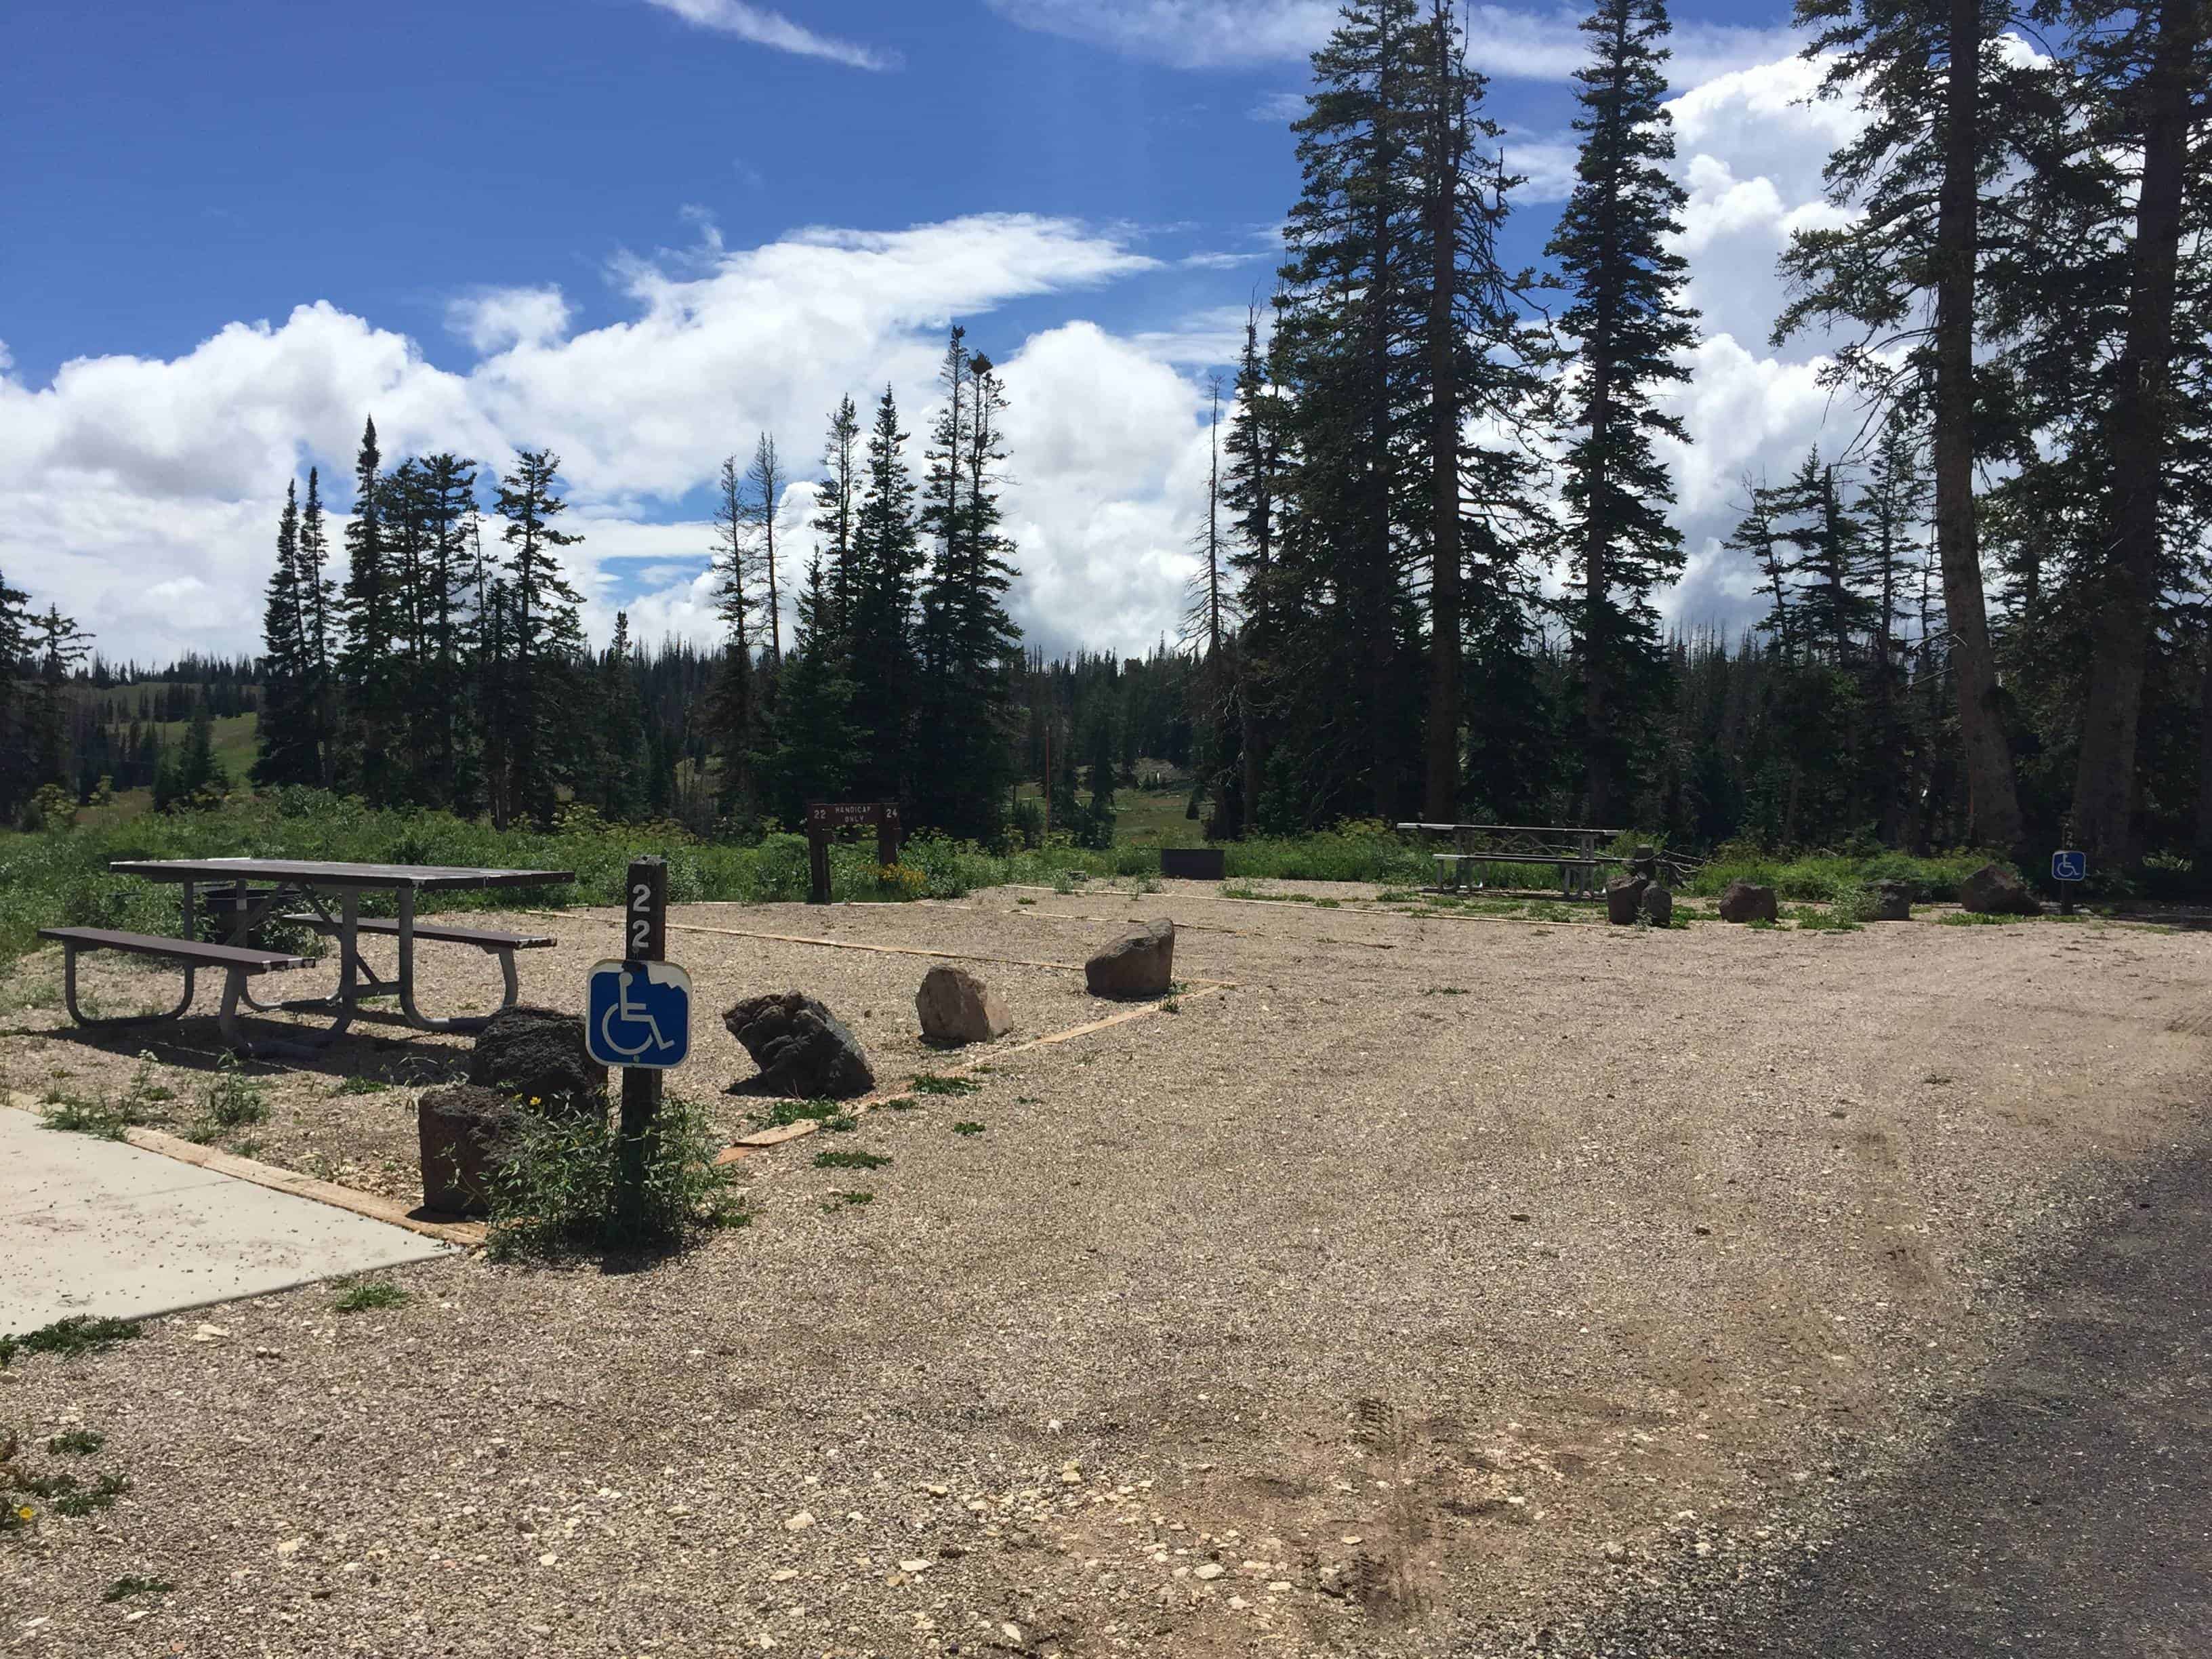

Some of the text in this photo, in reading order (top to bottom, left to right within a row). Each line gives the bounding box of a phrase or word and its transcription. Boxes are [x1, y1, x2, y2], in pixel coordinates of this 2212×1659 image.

[814, 809, 826, 819] 22
[886, 808, 898, 818] 24
[632, 884, 651, 948] 22
